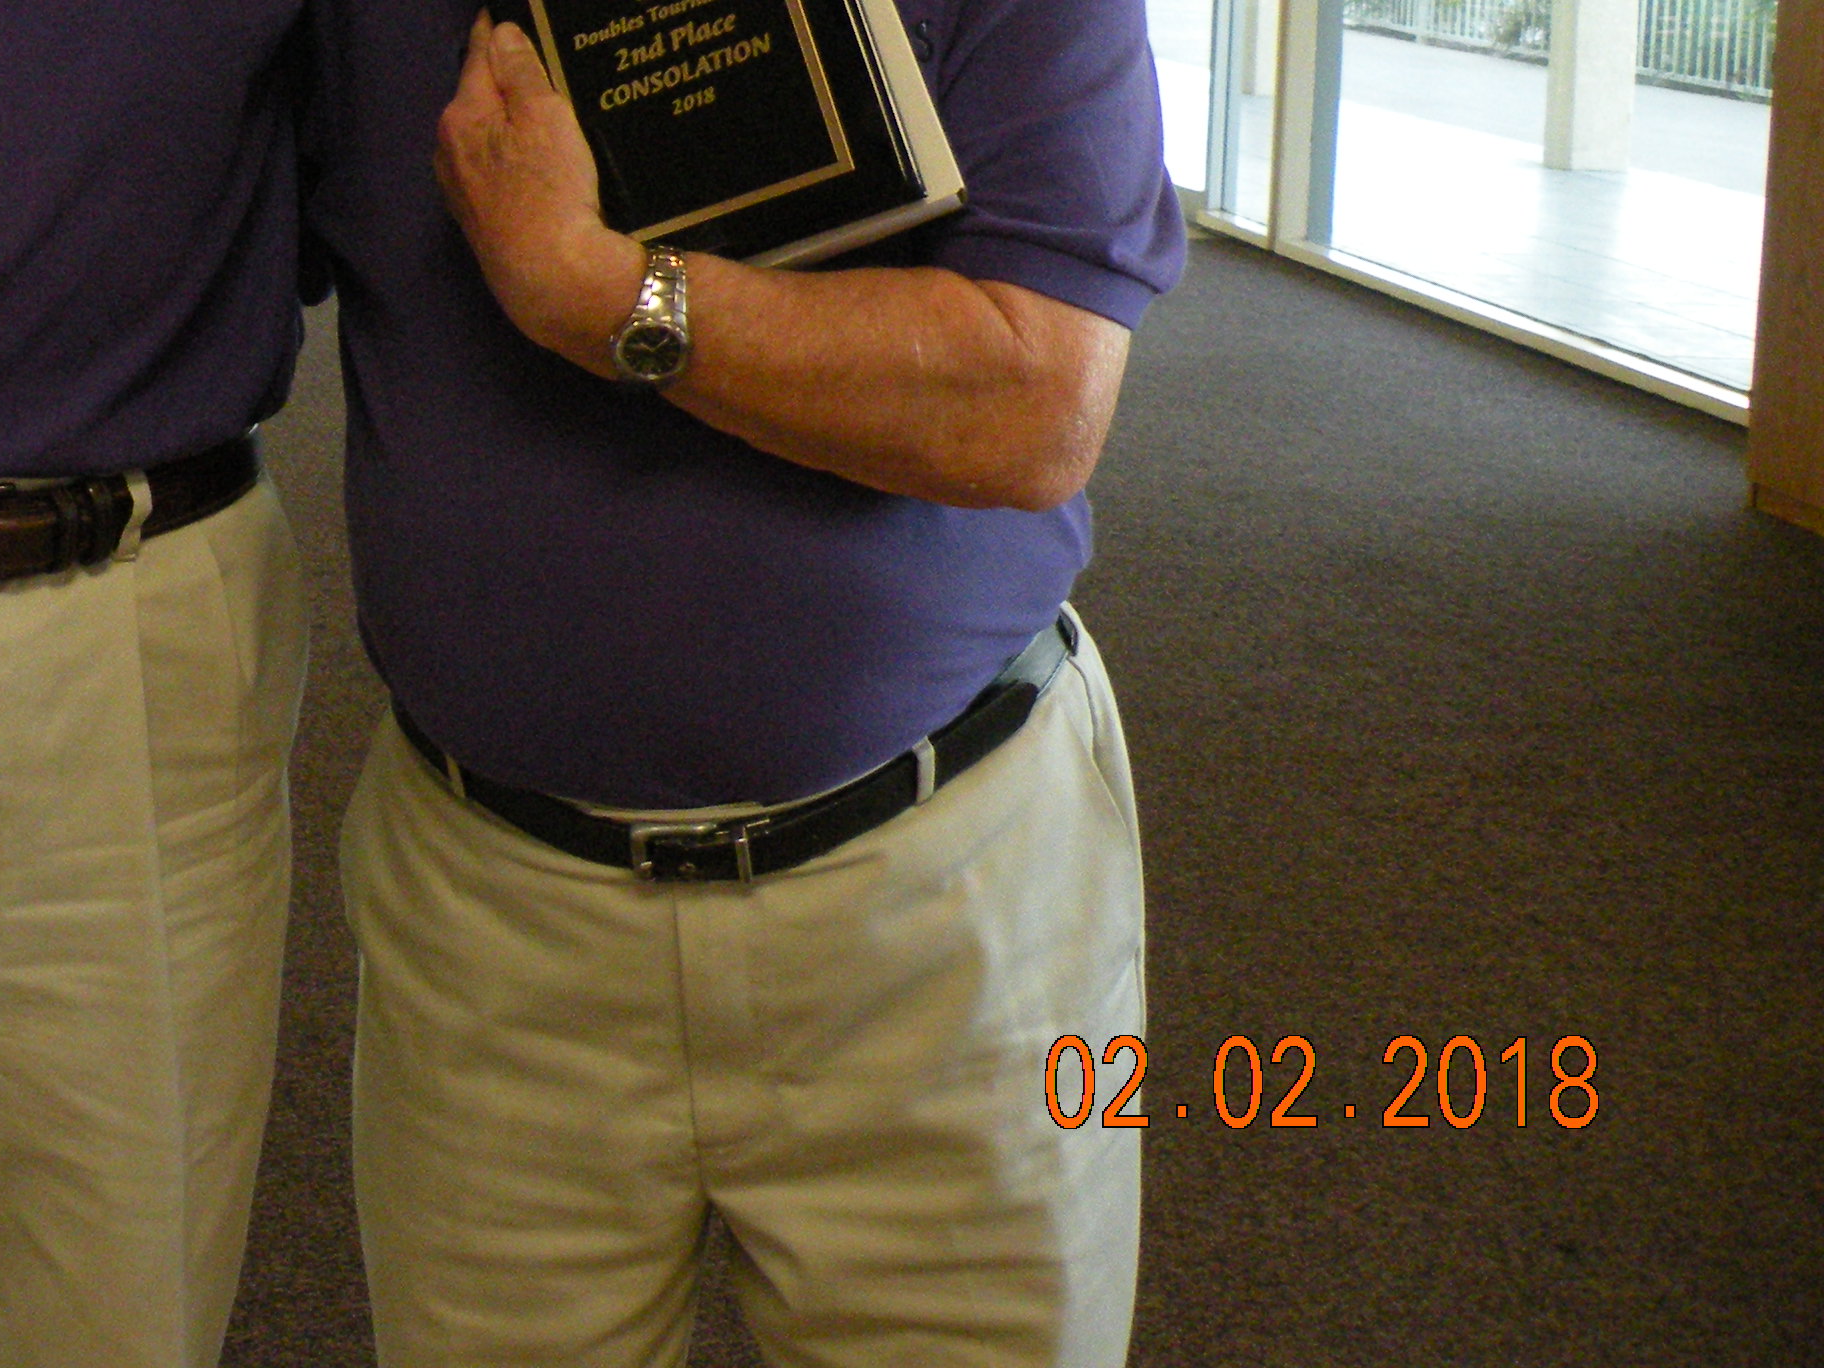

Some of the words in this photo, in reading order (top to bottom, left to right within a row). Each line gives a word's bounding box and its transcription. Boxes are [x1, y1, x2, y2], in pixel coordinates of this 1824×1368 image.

[573, 15, 645, 52] Doubles
[615, 31, 667, 72] 2nd
[669, 13, 737, 52] Place
[599, 31, 772, 111] CONSOLATION
[672, 85, 717, 116] 2018
